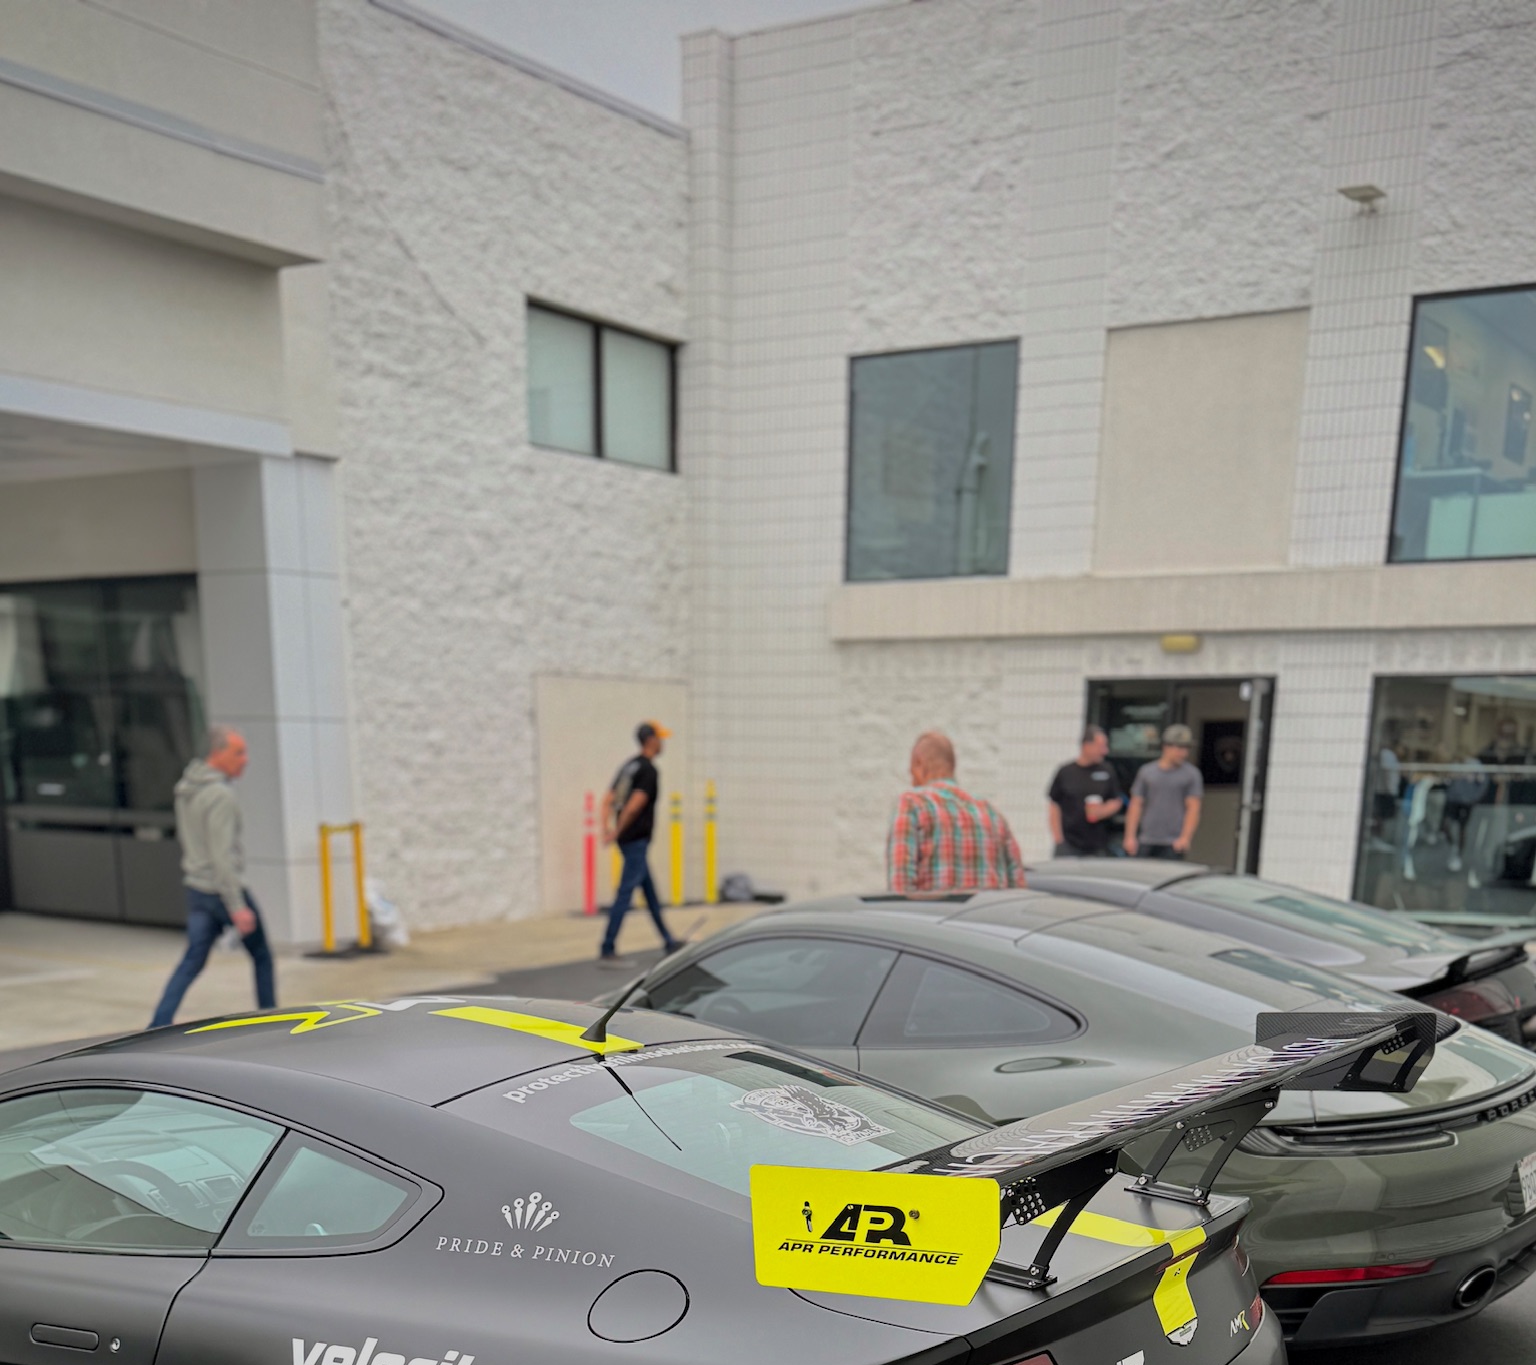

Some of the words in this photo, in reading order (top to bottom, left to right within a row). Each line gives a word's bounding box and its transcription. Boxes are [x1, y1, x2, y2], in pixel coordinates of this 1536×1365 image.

[1487, 1089, 1536, 1120] PORSC
[820, 1203, 912, 1246] APR
[436, 1236, 504, 1256] PRIDE
[510, 1243, 525, 1259] &
[532, 1245, 616, 1268] PINION
[777, 1241, 814, 1254] APR
[818, 1245, 960, 1266] PERFORMANCE
